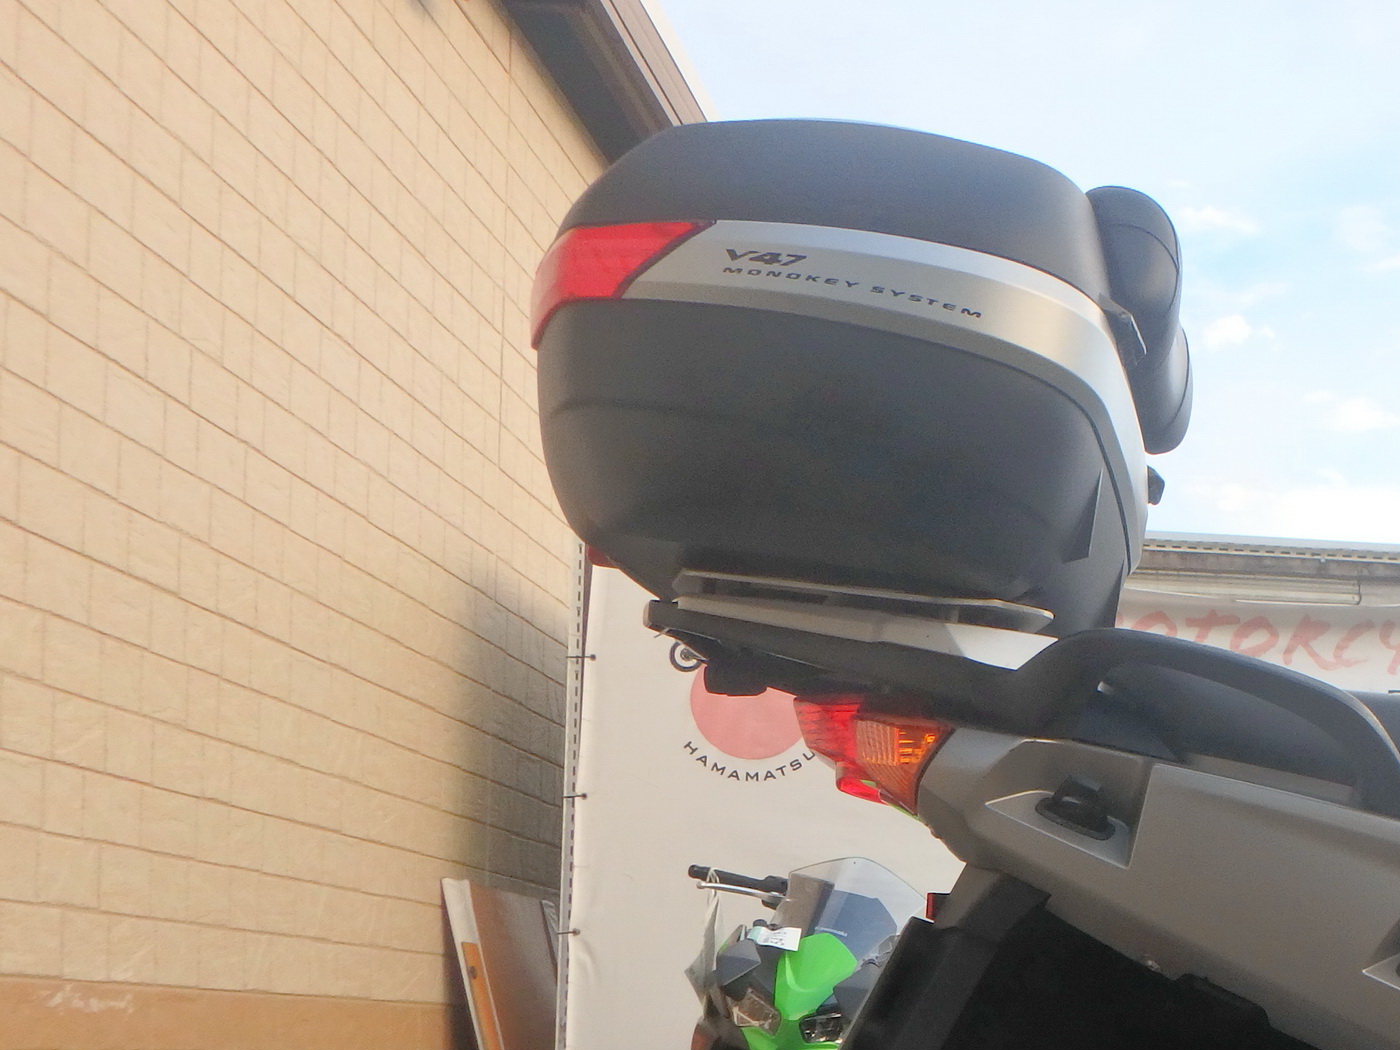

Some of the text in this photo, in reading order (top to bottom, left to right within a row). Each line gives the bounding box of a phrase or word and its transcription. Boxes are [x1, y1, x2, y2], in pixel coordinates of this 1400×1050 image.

[725, 248, 807, 267] V47
[722, 266, 982, 319] MONOKEY SYSTEM
[682, 740, 816, 782] HAMAMATSU
